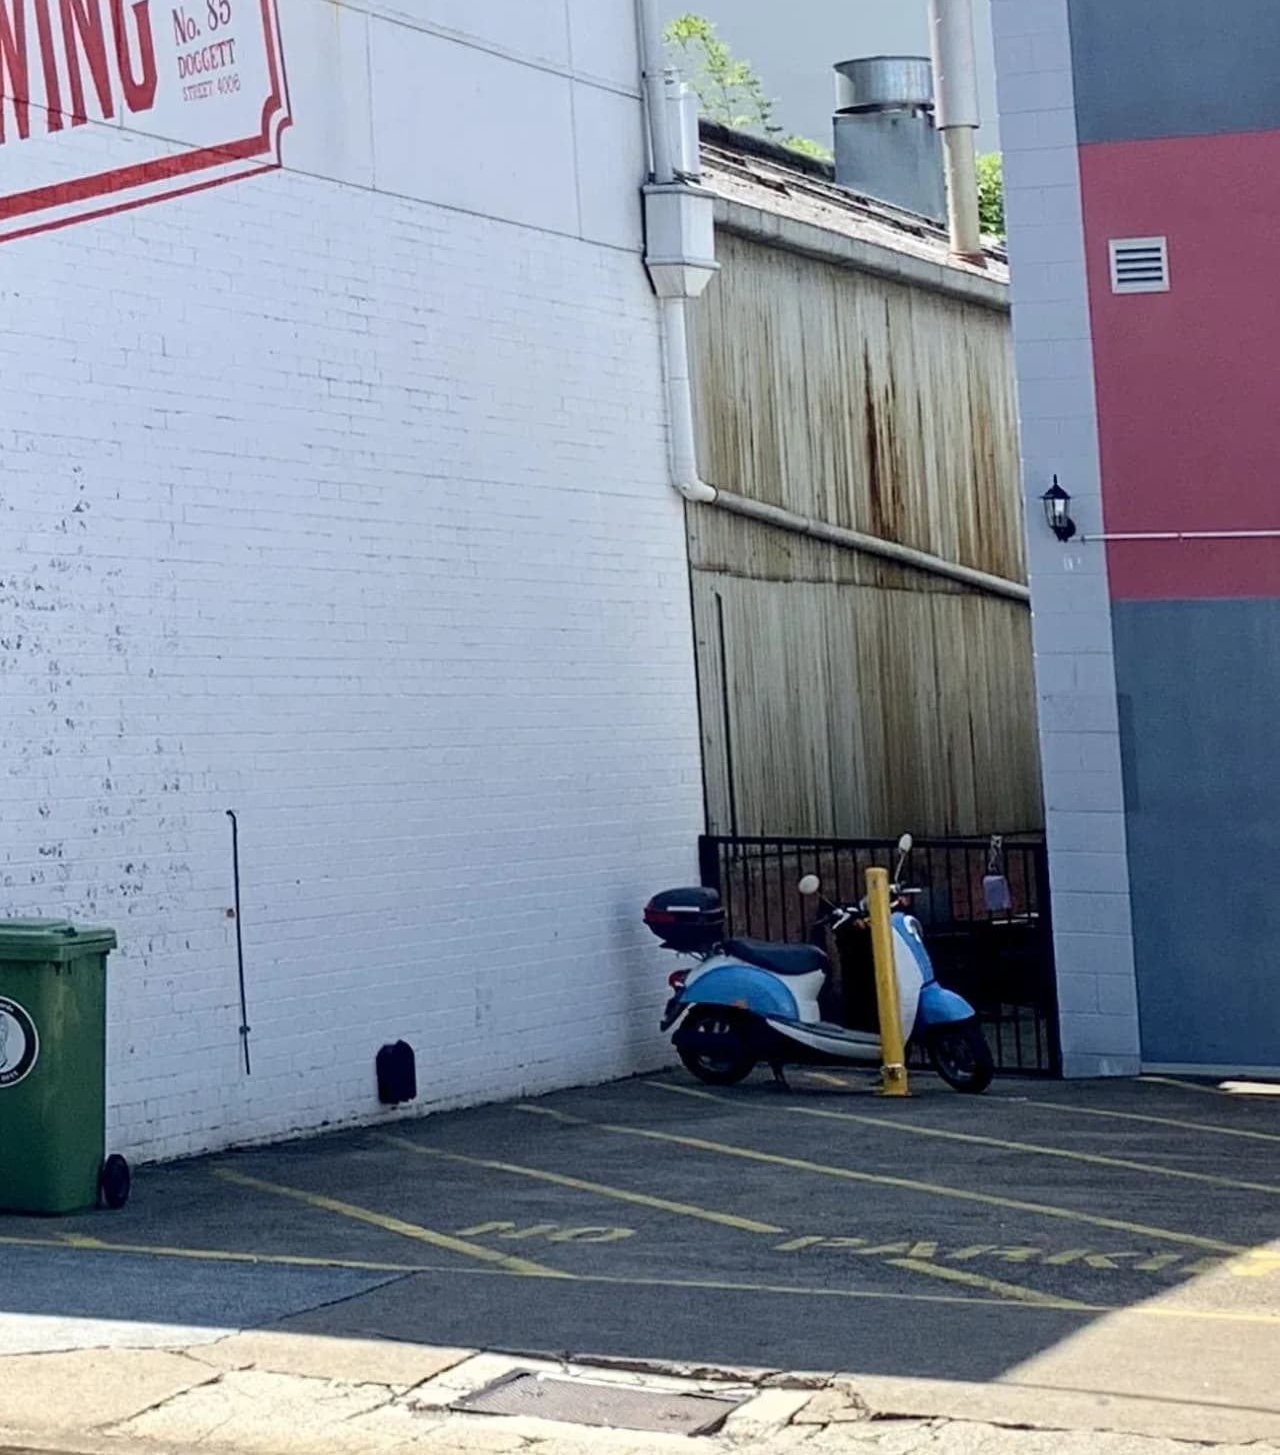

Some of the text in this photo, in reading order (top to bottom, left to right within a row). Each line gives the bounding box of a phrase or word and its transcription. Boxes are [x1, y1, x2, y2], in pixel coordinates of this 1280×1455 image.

[172, 6, 201, 46] No.
[177, 38, 237, 80] DOGGETT
[456, 1221, 637, 1243] NO
